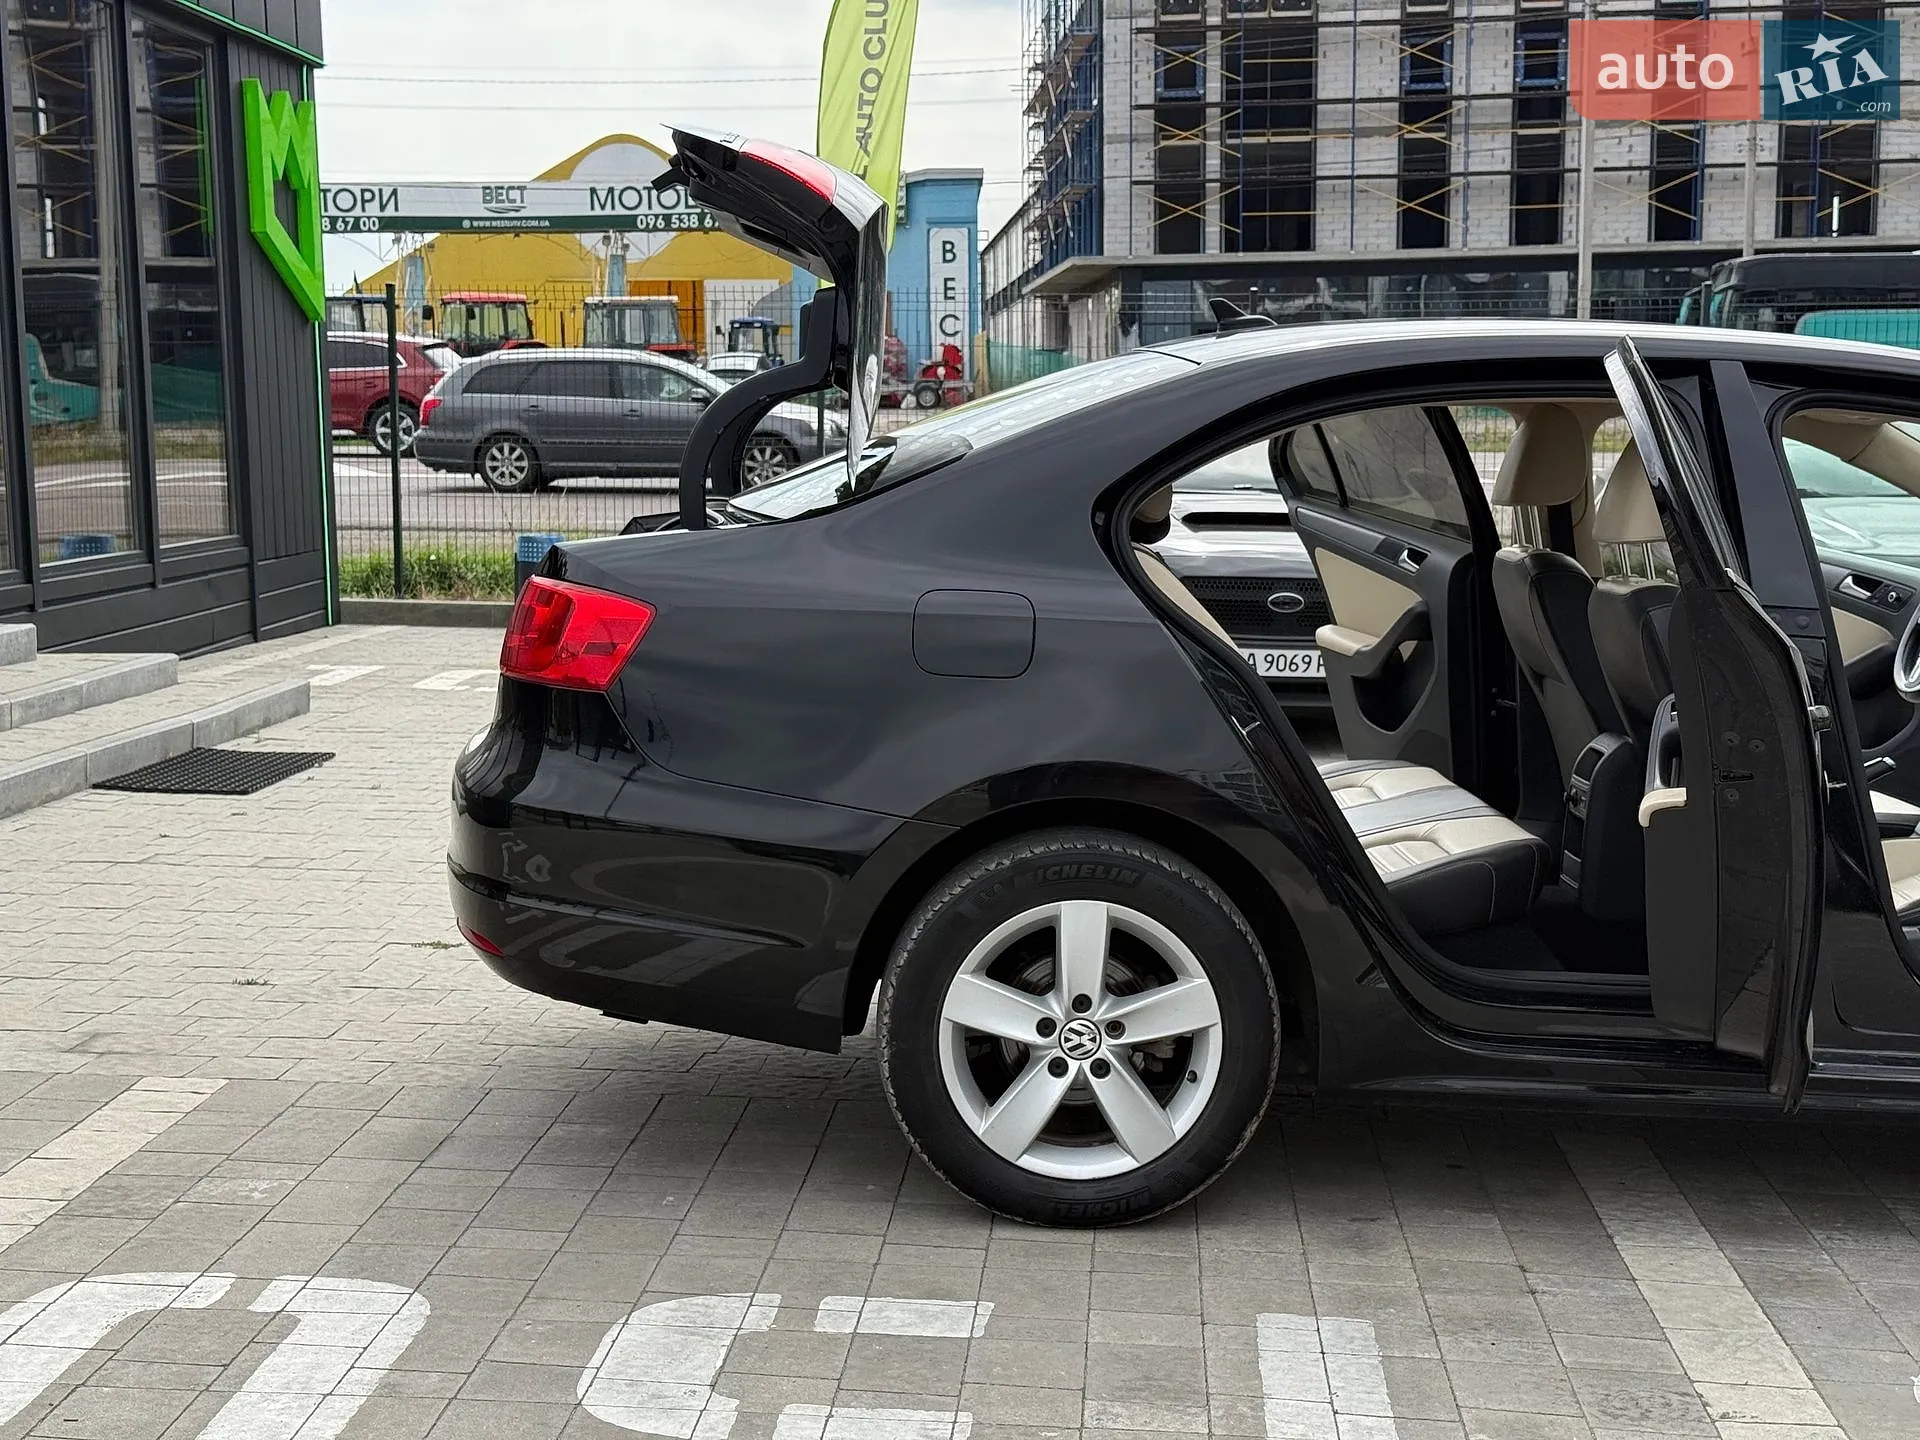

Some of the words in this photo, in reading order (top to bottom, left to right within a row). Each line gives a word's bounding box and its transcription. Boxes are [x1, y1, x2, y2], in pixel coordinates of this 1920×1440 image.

[856, 67, 883, 158] AUTO
[320, 188, 399, 213] ТОРИ
[482, 185, 527, 204] ВЕСТ
[336, 217, 354, 231] 67
[360, 217, 379, 231] 00
[636, 215, 665, 230] 096
[671, 214, 699, 229] 538
[1264, 653, 1312, 673] 9069
